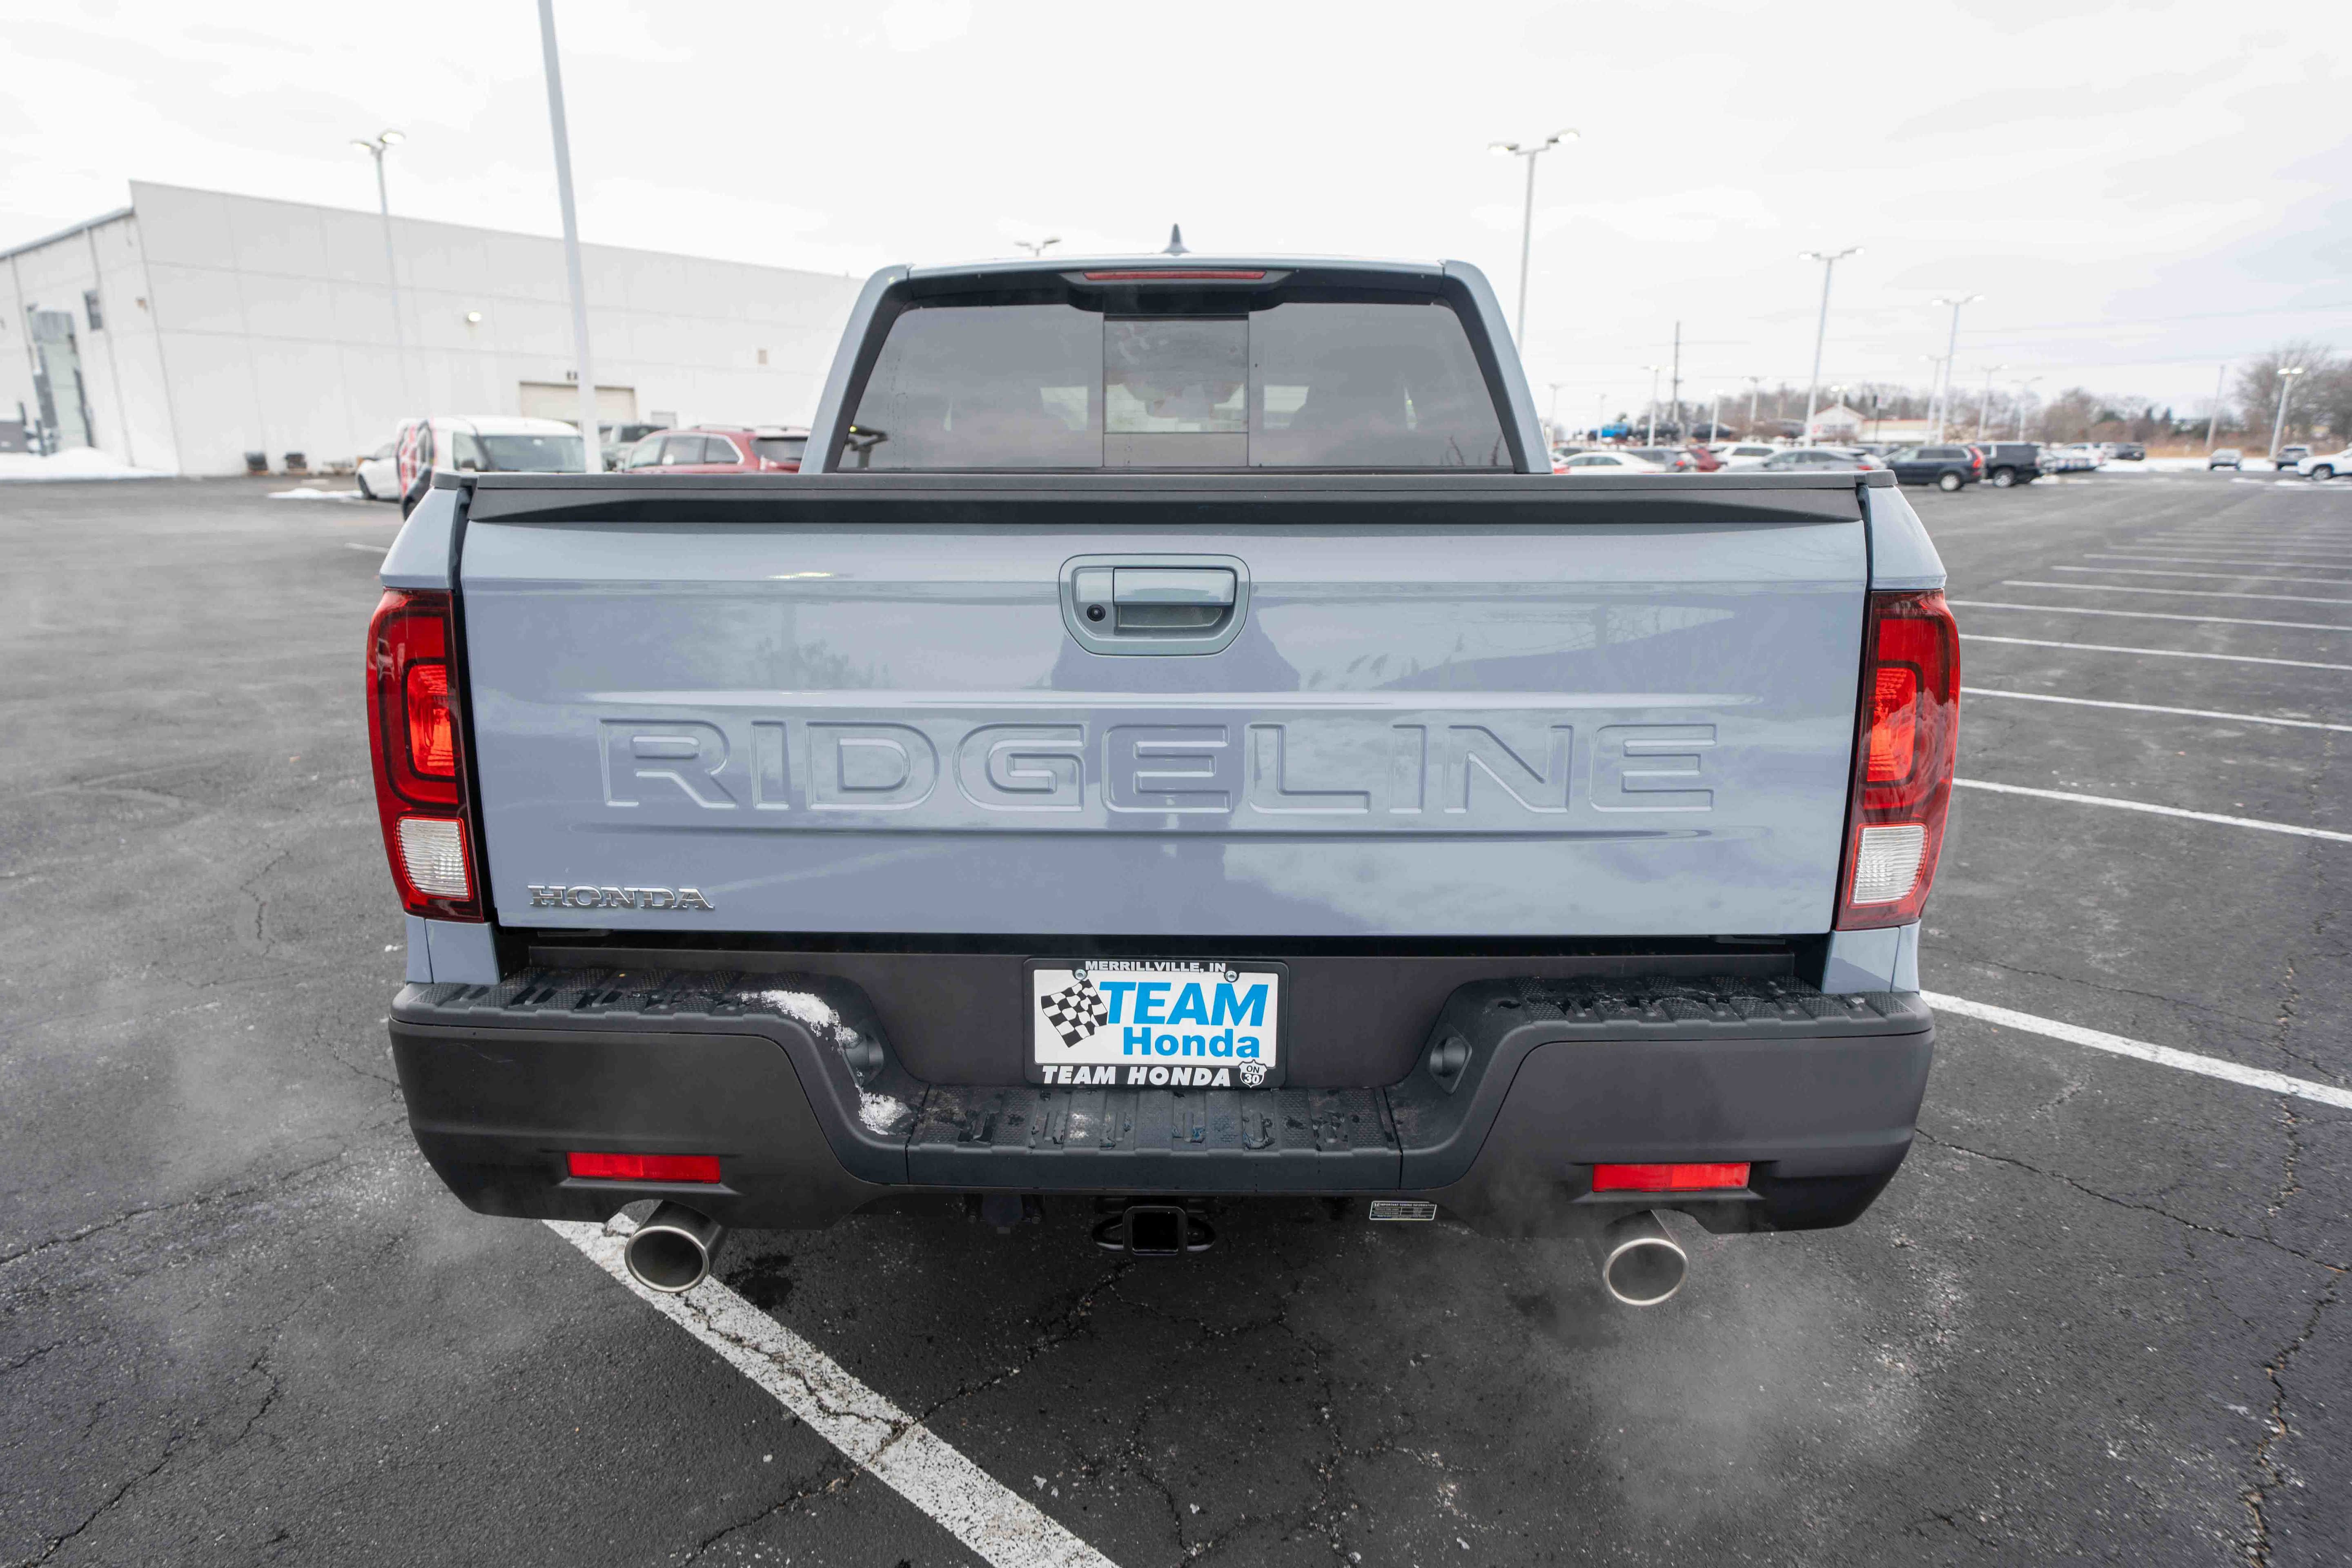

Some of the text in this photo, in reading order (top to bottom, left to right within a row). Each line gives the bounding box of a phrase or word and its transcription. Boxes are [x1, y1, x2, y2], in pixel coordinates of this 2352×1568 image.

[598, 717, 1717, 813] RIDGELINE
[527, 884, 716, 911] HONDA
[1085, 960, 1226, 973] MERRILLVILLE, IN
[1099, 981, 1269, 1027] TEAM
[1123, 1027, 1260, 1058] Honda
[1042, 1066, 1231, 1087] TEAM HONDA
[1244, 1074, 1260, 1085] 30
[1246, 1065, 1260, 1074] ON
